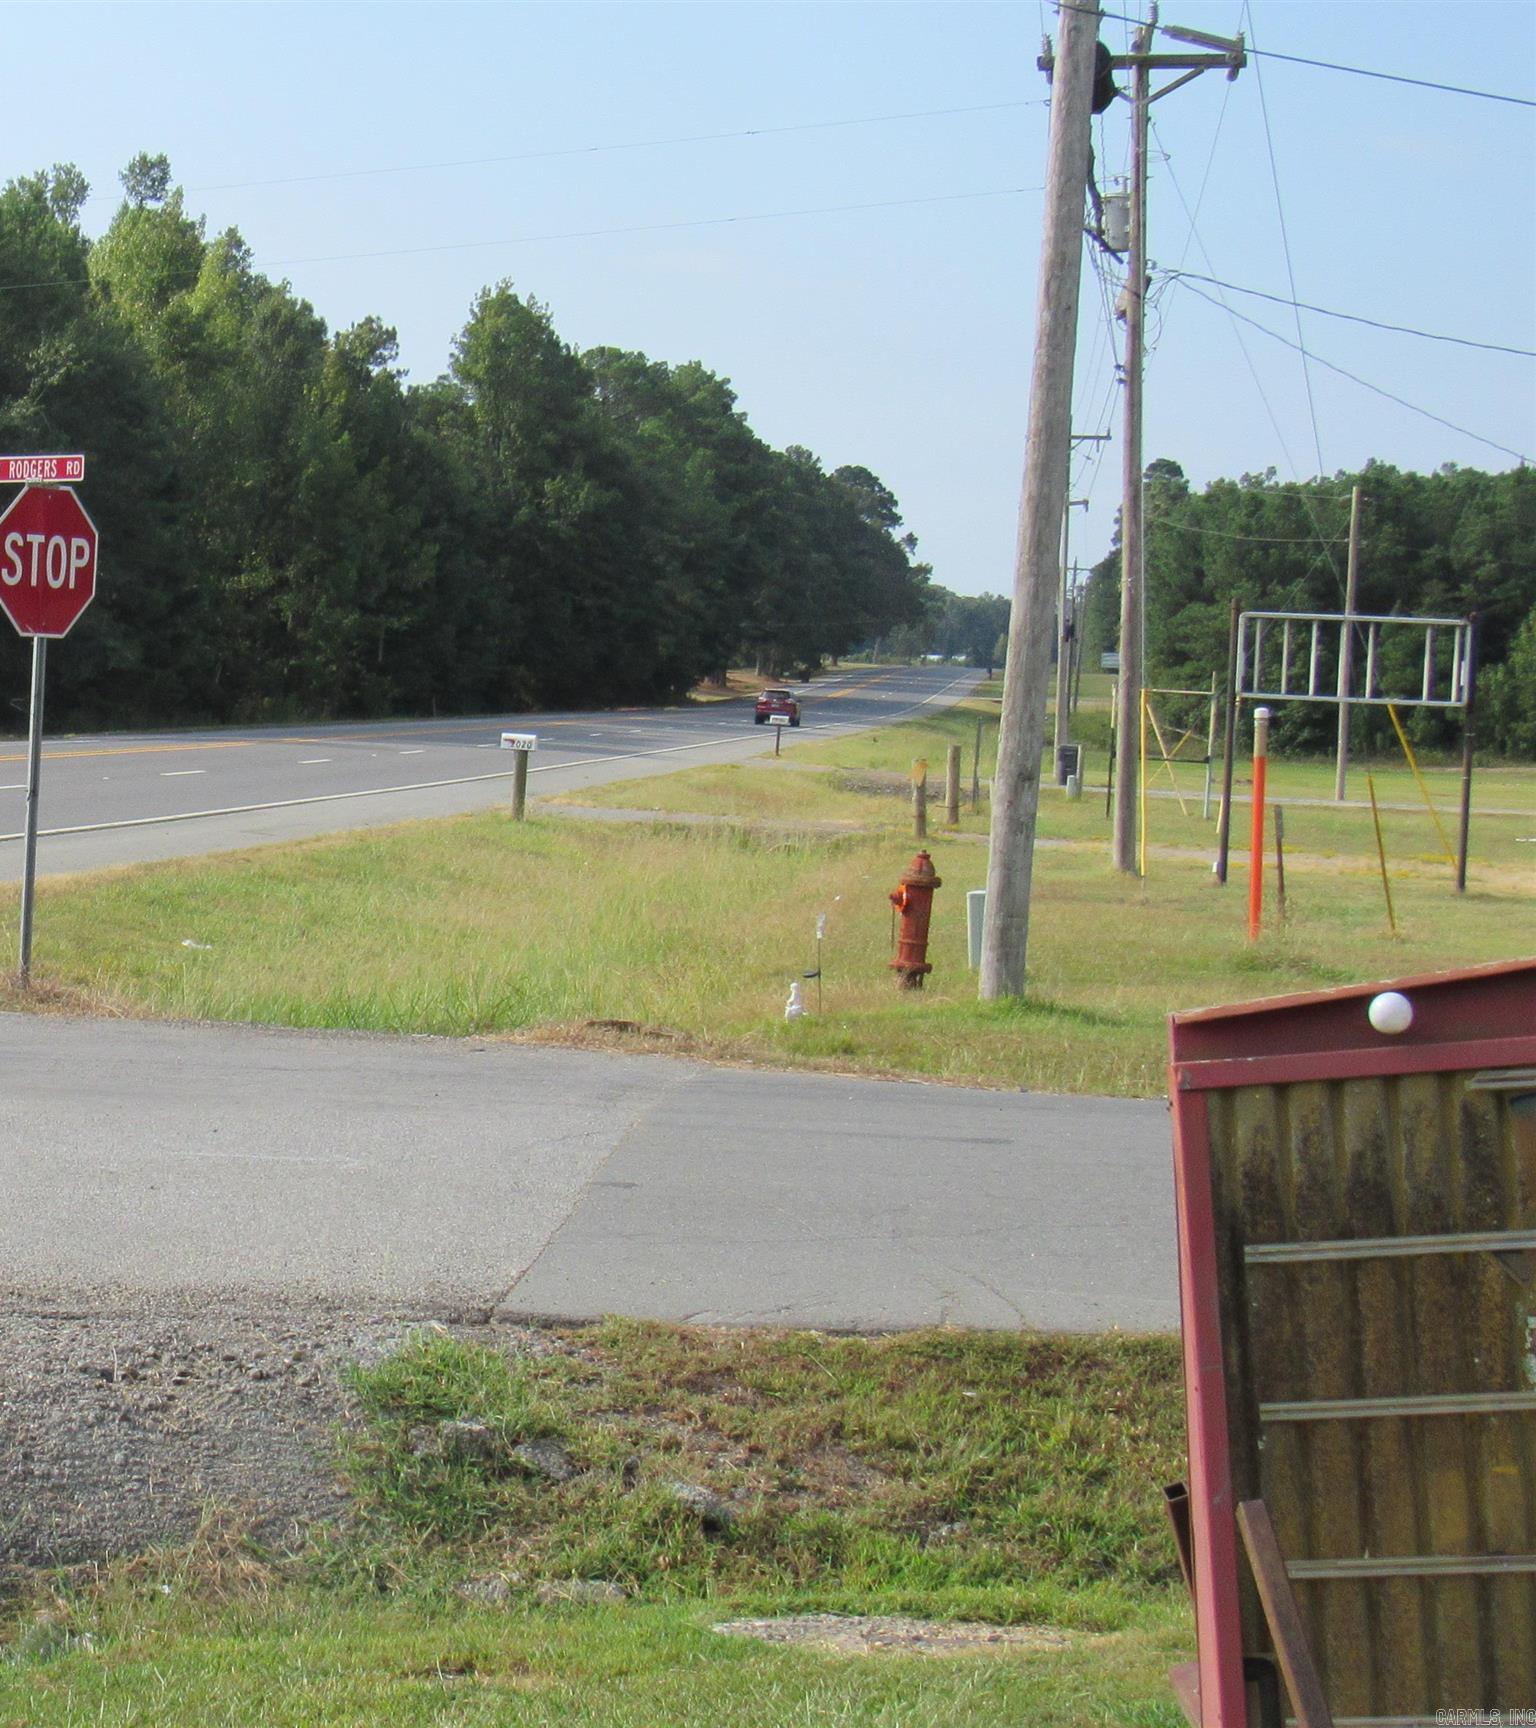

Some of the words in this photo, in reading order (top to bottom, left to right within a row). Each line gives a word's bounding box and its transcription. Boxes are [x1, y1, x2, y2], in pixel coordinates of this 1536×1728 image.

[9, 460, 57, 479] RODGERS
[66, 461, 80, 475] RD
[1, 532, 90, 590] STOP
